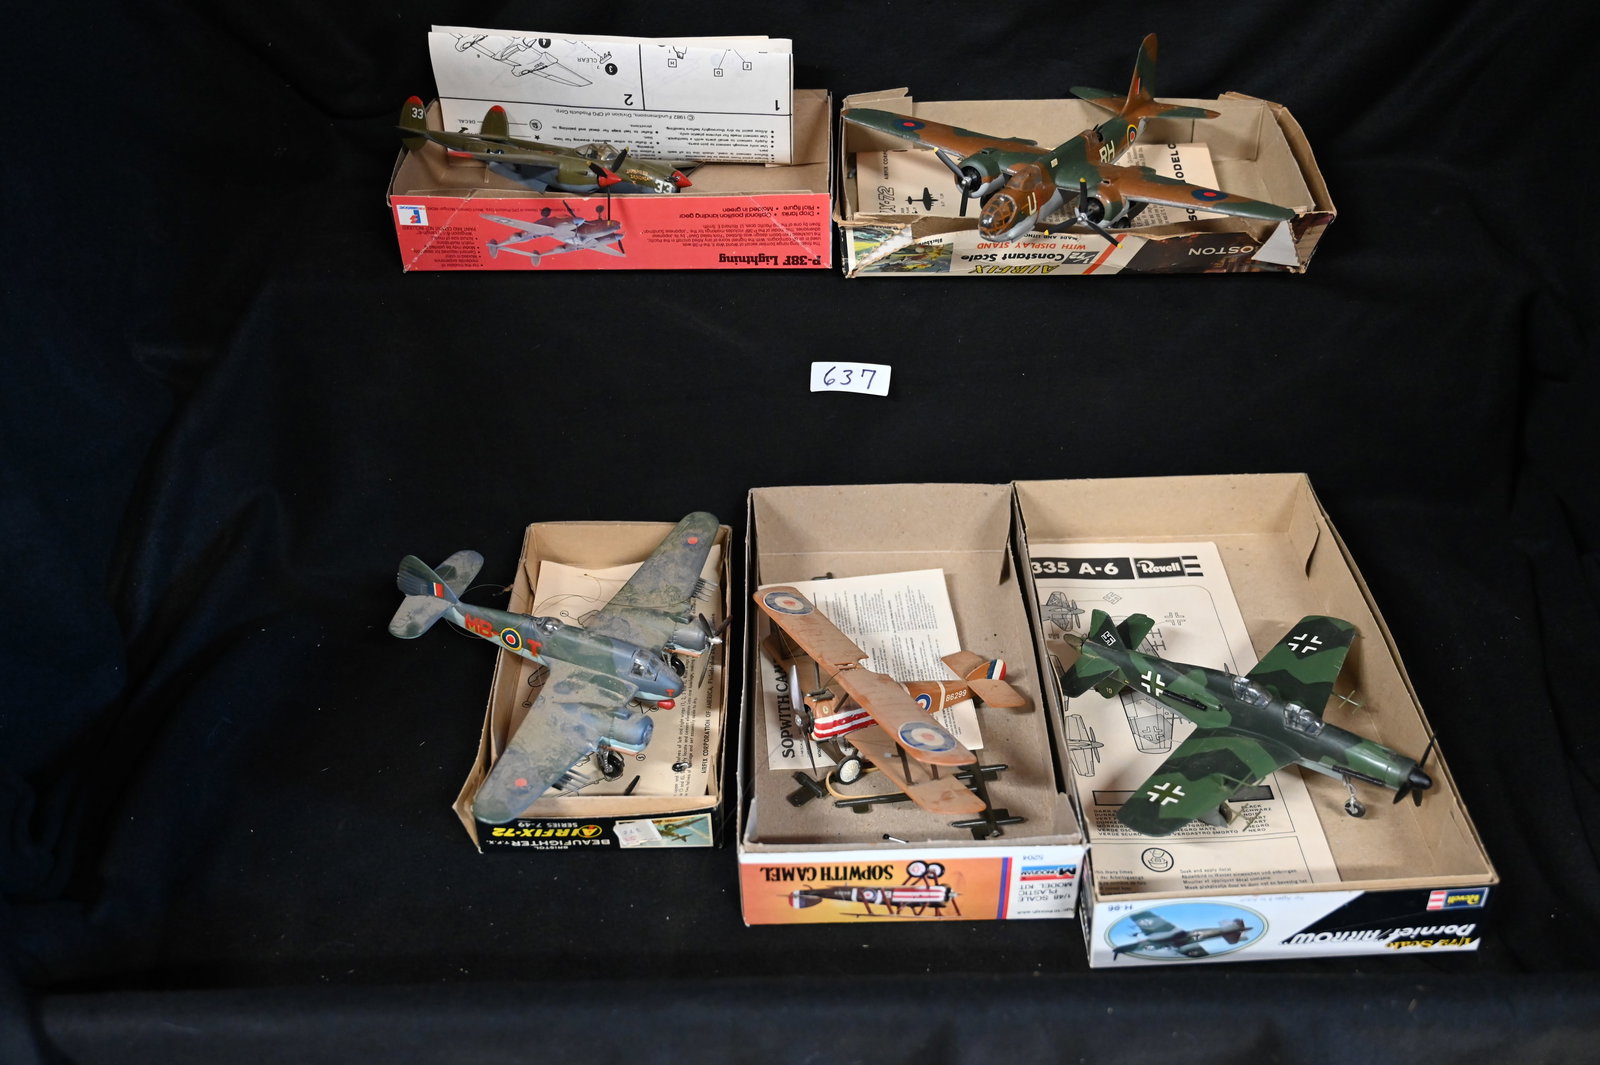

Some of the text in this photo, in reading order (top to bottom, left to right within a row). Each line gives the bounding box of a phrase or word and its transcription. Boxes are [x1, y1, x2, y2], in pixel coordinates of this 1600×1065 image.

[624, 94, 634, 106] 2
[775, 100, 780, 111] 1
[412, 107, 424, 120] 33
[1098, 140, 1116, 164] RH
[1170, 151, 1184, 180] ODEL
[654, 179, 674, 194] 33
[1016, 242, 1056, 250] DISPLAY
[1188, 244, 1258, 256] OSTON
[718, 254, 821, 266] P-38F Lightning
[961, 253, 997, 262] Scale
[1002, 252, 1065, 262] Constant
[968, 264, 1060, 274] AIRFIX
[824, 366, 876, 389] 637
[1031, 562, 1119, 575] 335 A-6
[1136, 560, 1181, 574] Revell
[527, 638, 543, 657] T
[777, 695, 795, 758] SOPWITH
[702, 720, 711, 757] CORPORATION
[492, 825, 602, 838] AIRFIX-72
[511, 839, 610, 847] BEAUFIGHTER
[760, 866, 893, 882] SOPWITH CAMEL
[1021, 868, 1076, 876] MONOGRAM
[1448, 894, 1480, 906] Revell
[1387, 924, 1476, 941] Dornier
[1385, 936, 1472, 949] 1/72 Scale
